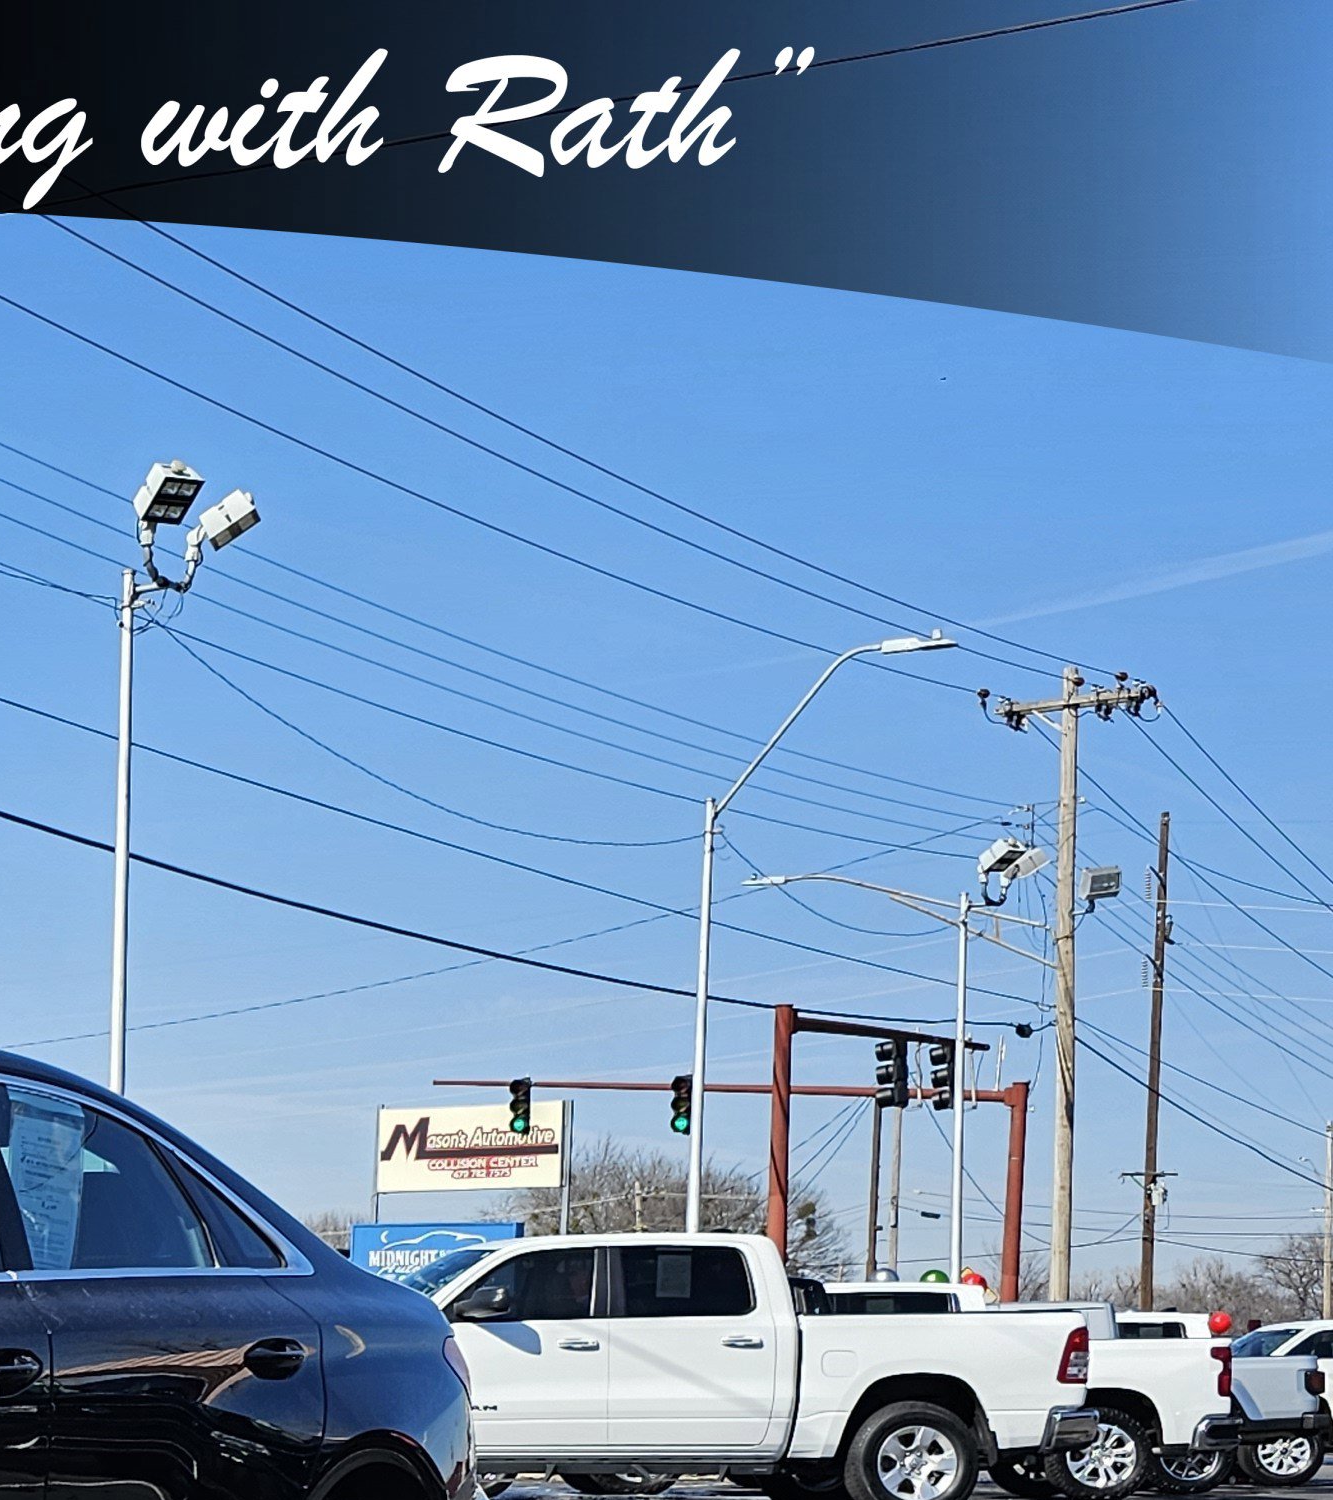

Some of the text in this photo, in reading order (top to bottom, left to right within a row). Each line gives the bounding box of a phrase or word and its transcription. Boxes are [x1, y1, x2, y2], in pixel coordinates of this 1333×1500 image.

[428, 1156, 538, 1171] COLLISION CENTER
[369, 1249, 438, 1267] MIDNIGHT
